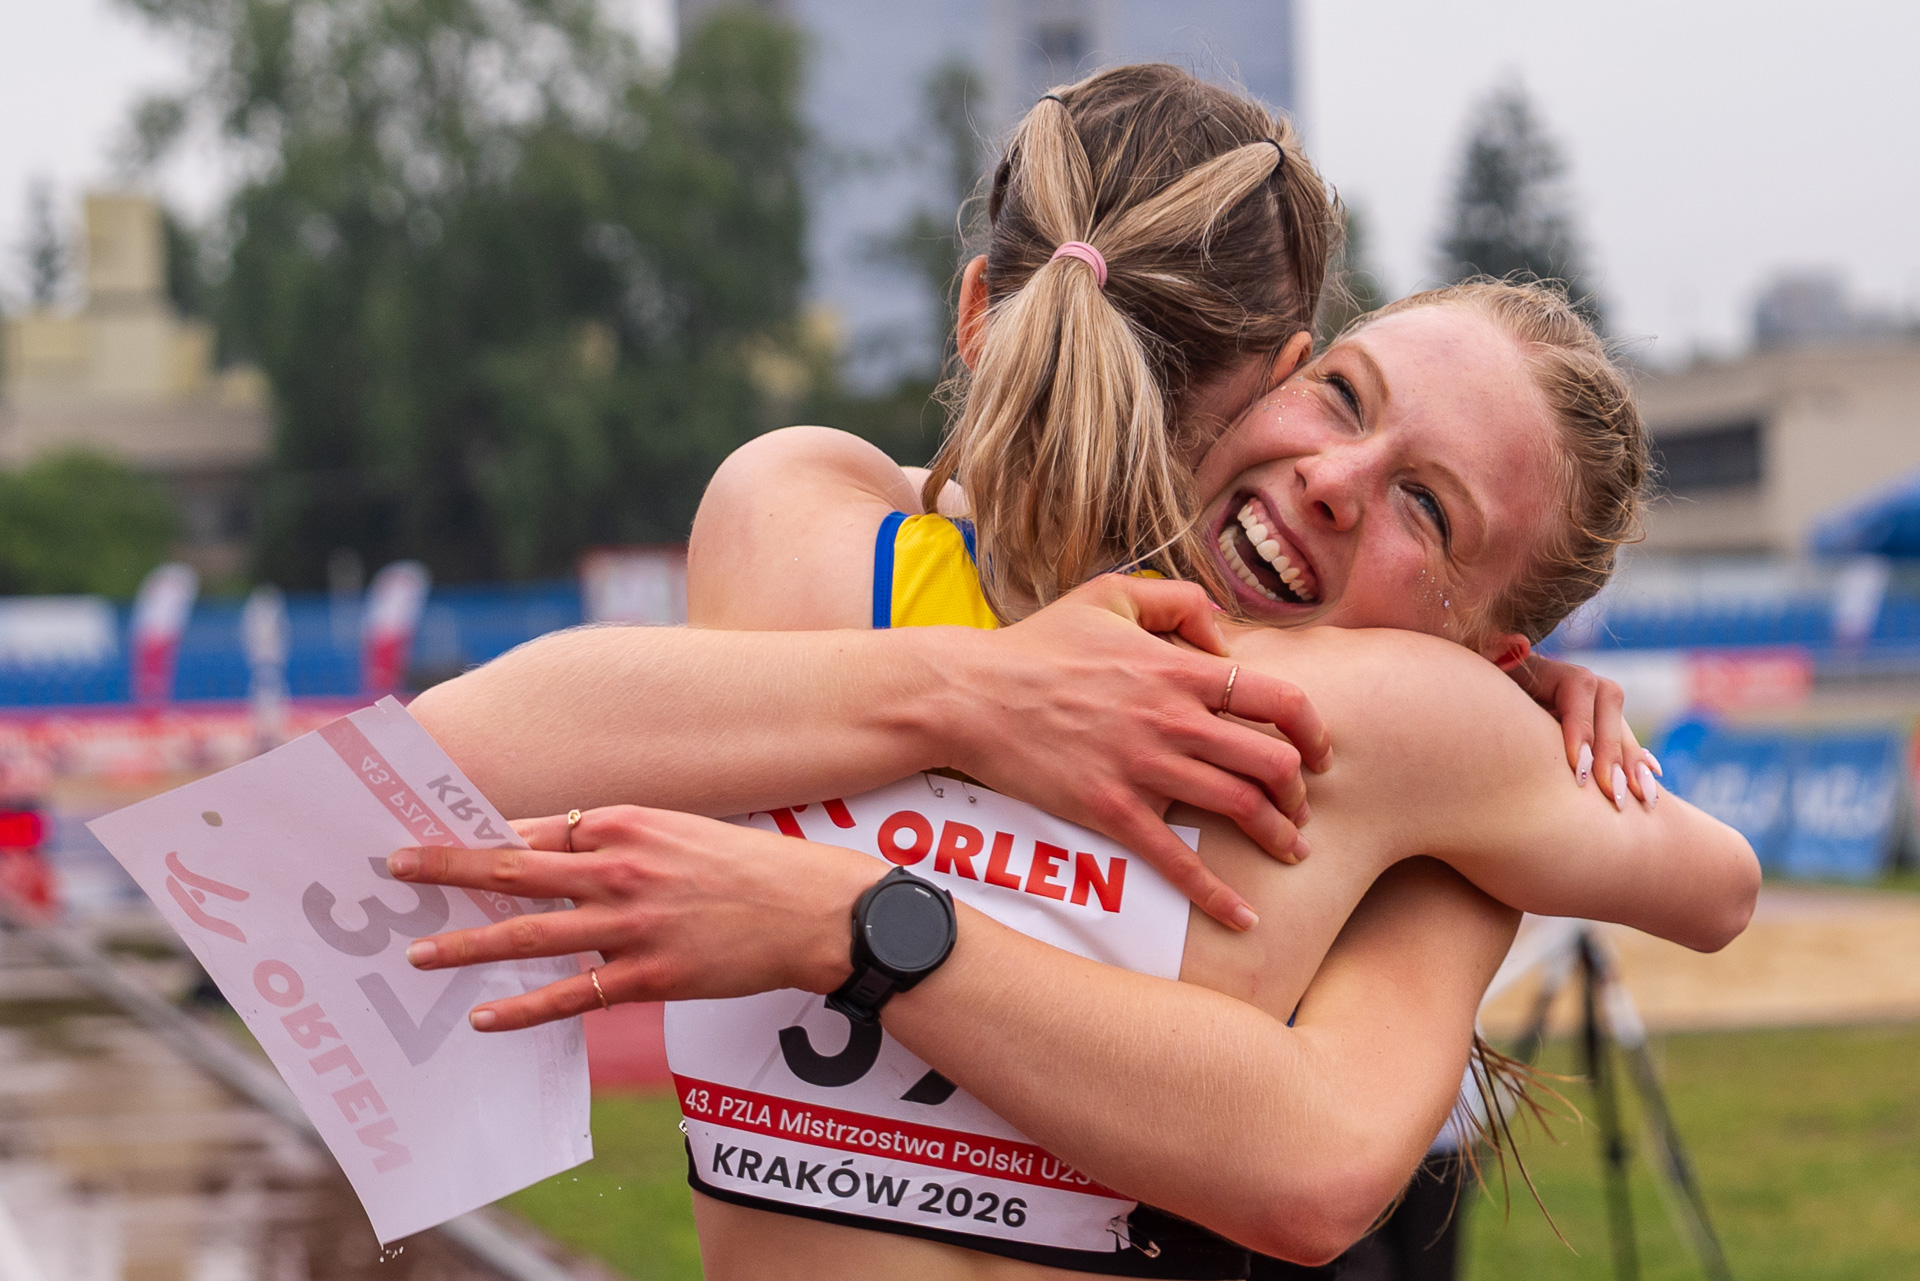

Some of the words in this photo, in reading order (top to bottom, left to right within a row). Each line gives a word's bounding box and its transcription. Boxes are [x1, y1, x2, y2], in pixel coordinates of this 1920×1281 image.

[877, 810, 1128, 913] ORLEN
[685, 1088, 713, 1114] 43.
[718, 1096, 771, 1127] PZLA
[779, 1109, 945, 1160] Mistrzostwa
[952, 1141, 1034, 1176] Polski
[712, 1142, 910, 1207] KRAKÓW
[917, 1182, 1028, 1228] 2026
